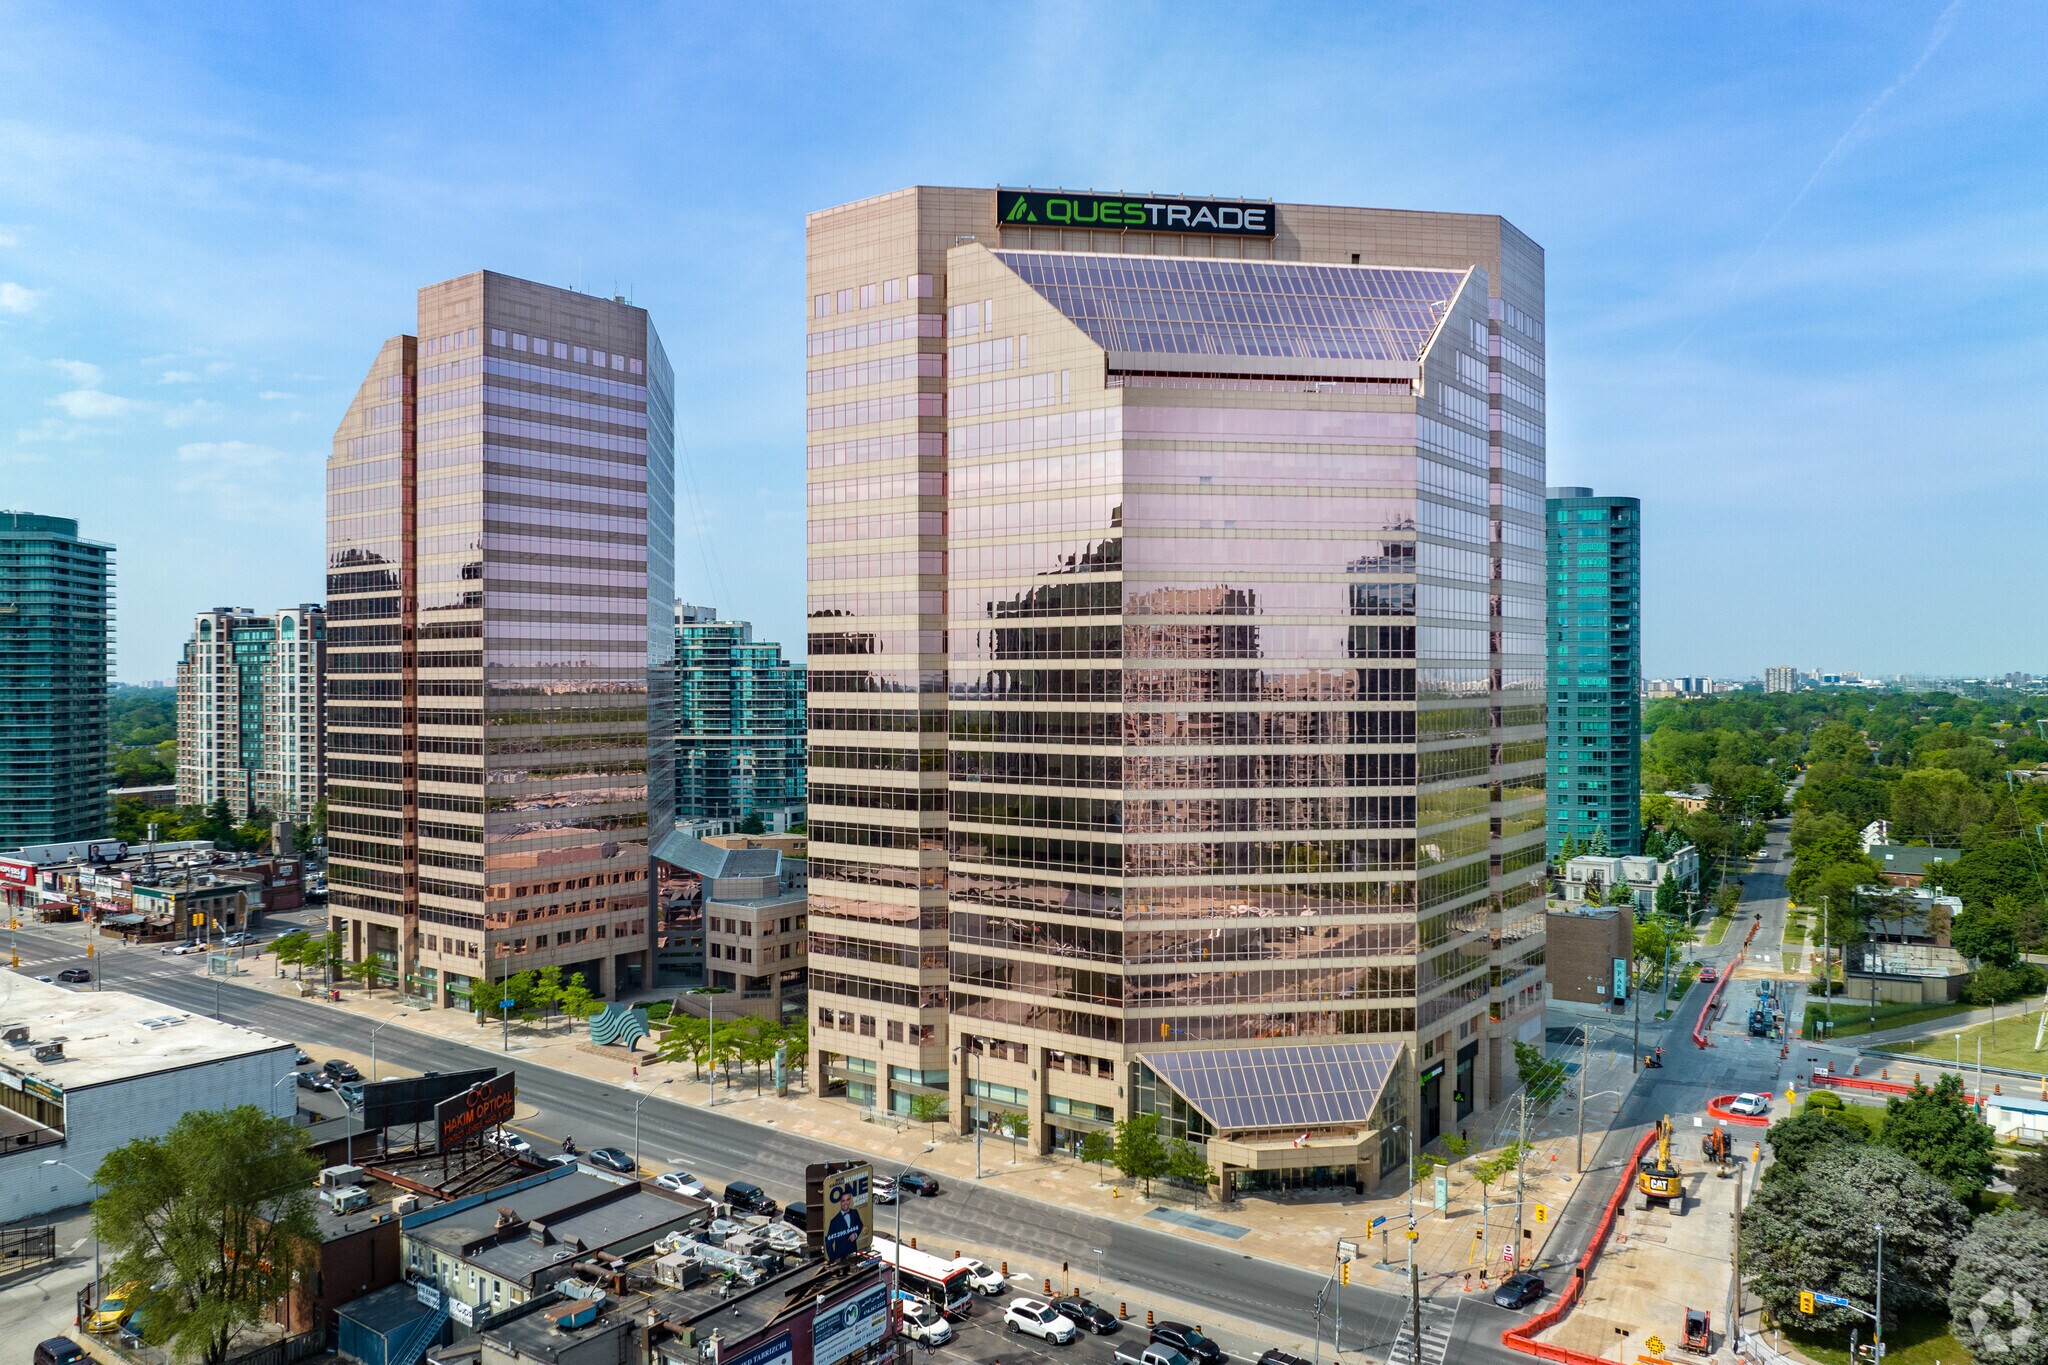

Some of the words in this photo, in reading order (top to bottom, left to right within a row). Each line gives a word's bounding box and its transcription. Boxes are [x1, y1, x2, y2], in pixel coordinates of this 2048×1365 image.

[1046, 199, 1266, 231] QUESTRADE
[444, 1110, 474, 1135] HAKIM
[477, 1091, 512, 1117] OPTICAL
[844, 1171, 869, 1183] NUMBER
[1650, 1178, 1668, 1191] CAT
[830, 1177, 868, 1203] ONE
[754, 1341, 786, 1363] TABRIZCHI
